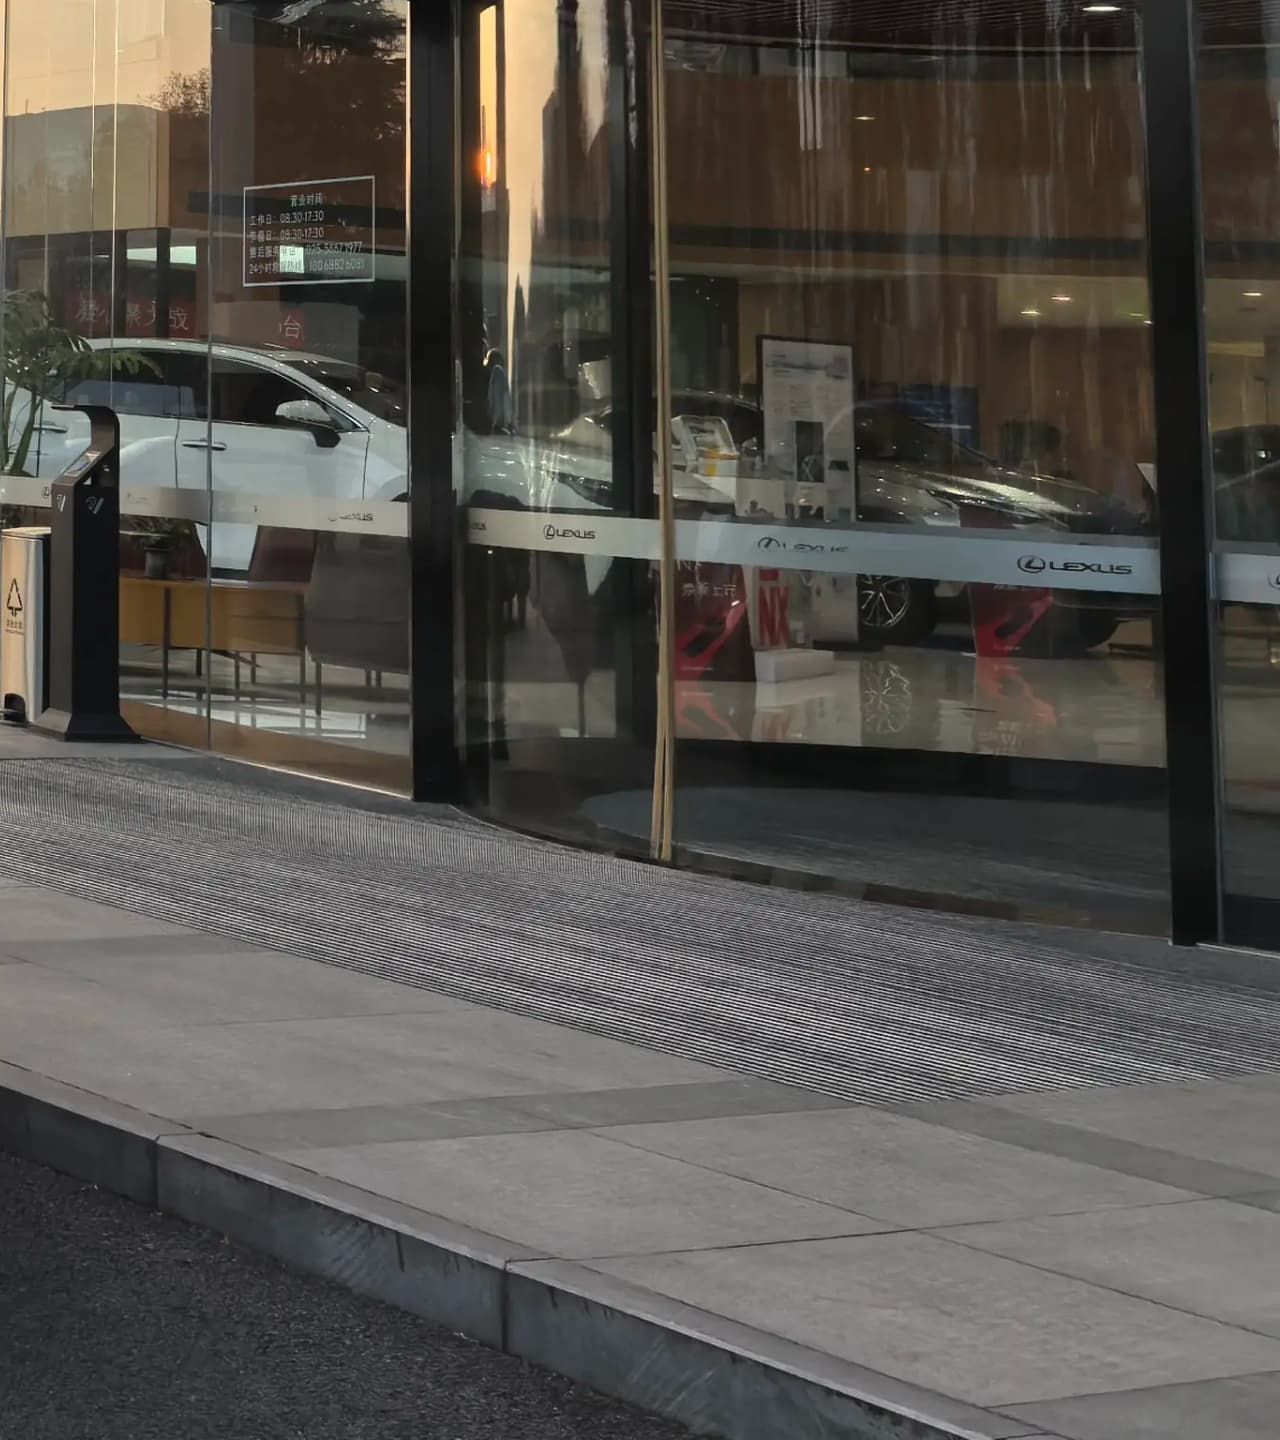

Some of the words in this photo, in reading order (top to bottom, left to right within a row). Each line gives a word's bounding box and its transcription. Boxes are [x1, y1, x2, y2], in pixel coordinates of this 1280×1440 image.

[556, 528, 596, 539] LEXUS
[1049, 561, 1133, 575] LEXUS
[759, 586, 791, 648] NX
